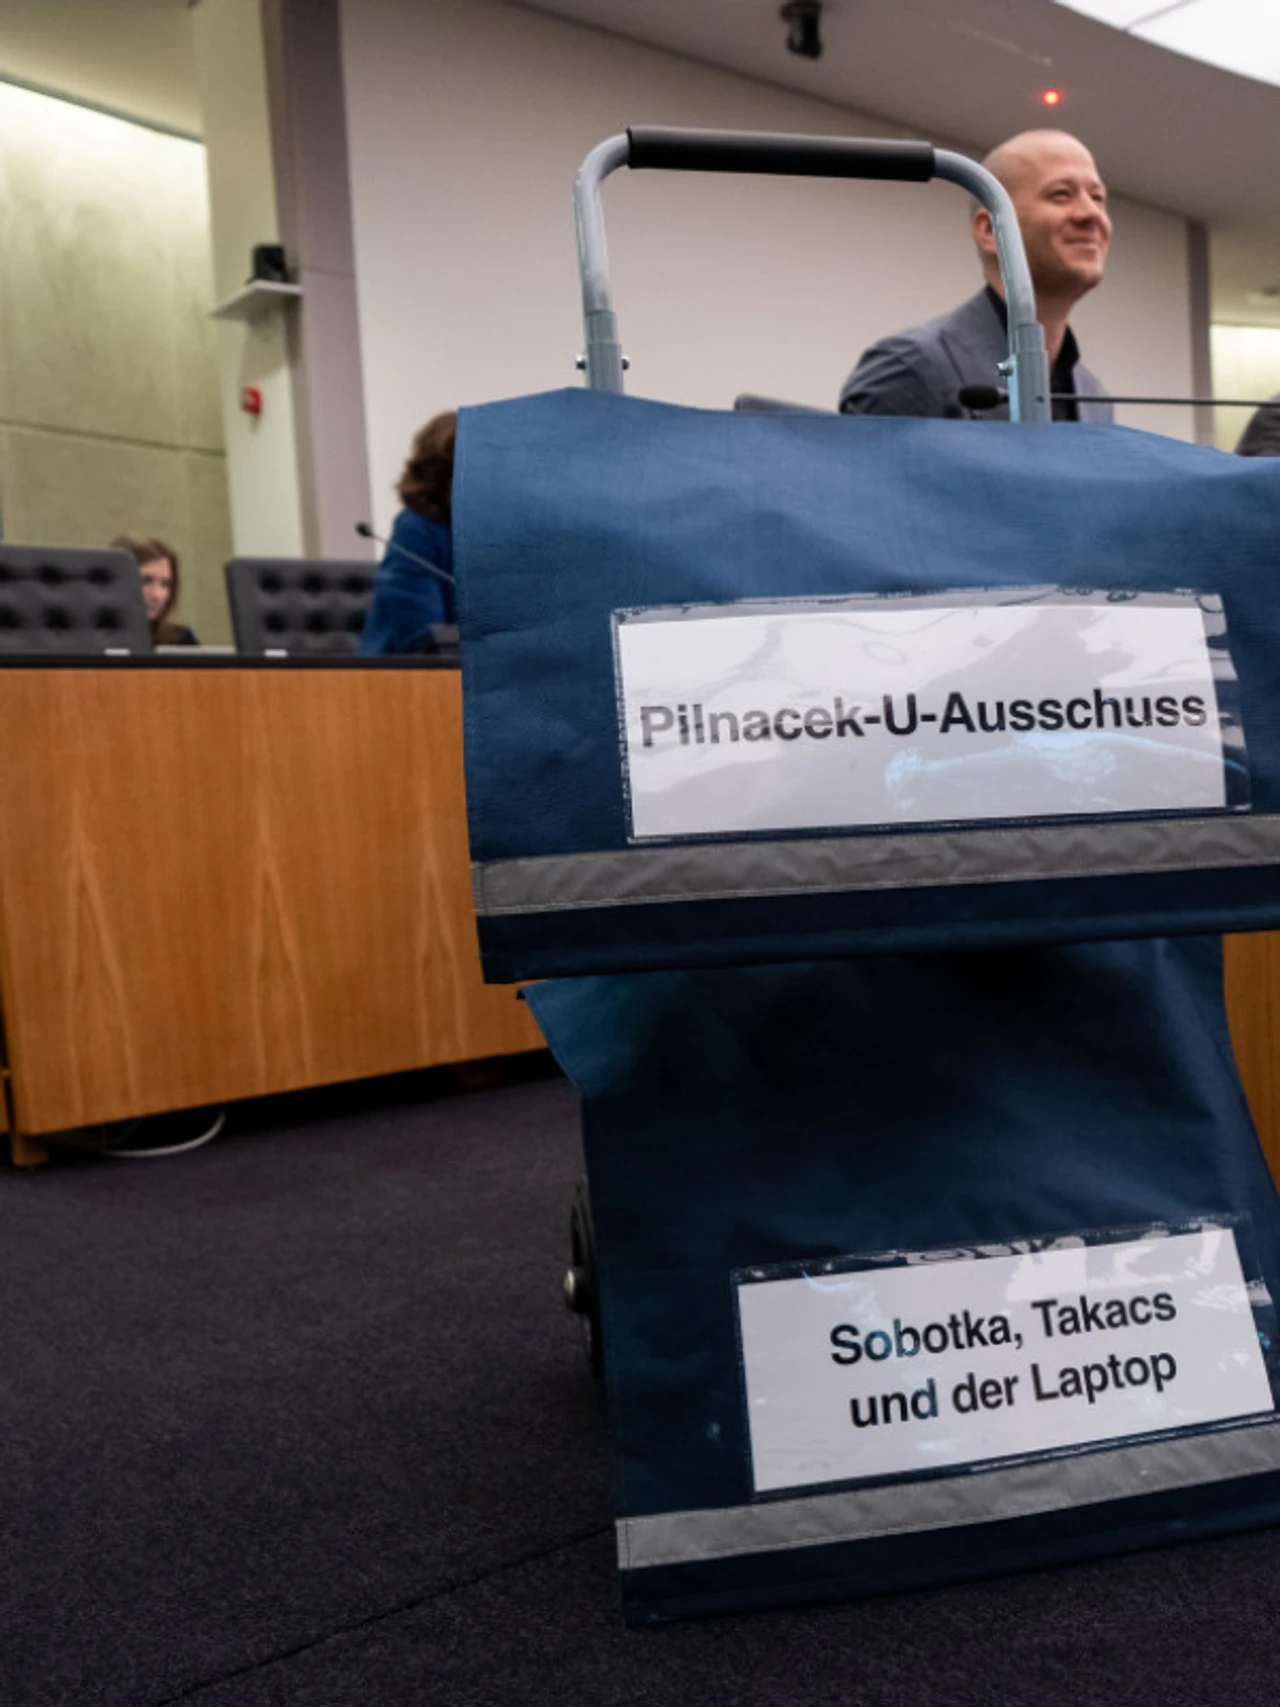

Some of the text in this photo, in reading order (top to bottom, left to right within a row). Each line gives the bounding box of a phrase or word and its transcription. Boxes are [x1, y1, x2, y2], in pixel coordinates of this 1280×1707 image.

[640, 688, 1207, 747] Pilnacek-U-Ausschuss
[829, 1291, 1177, 1365] Sobotka, Takacs
[850, 1352, 1177, 1428] und der Laptop
